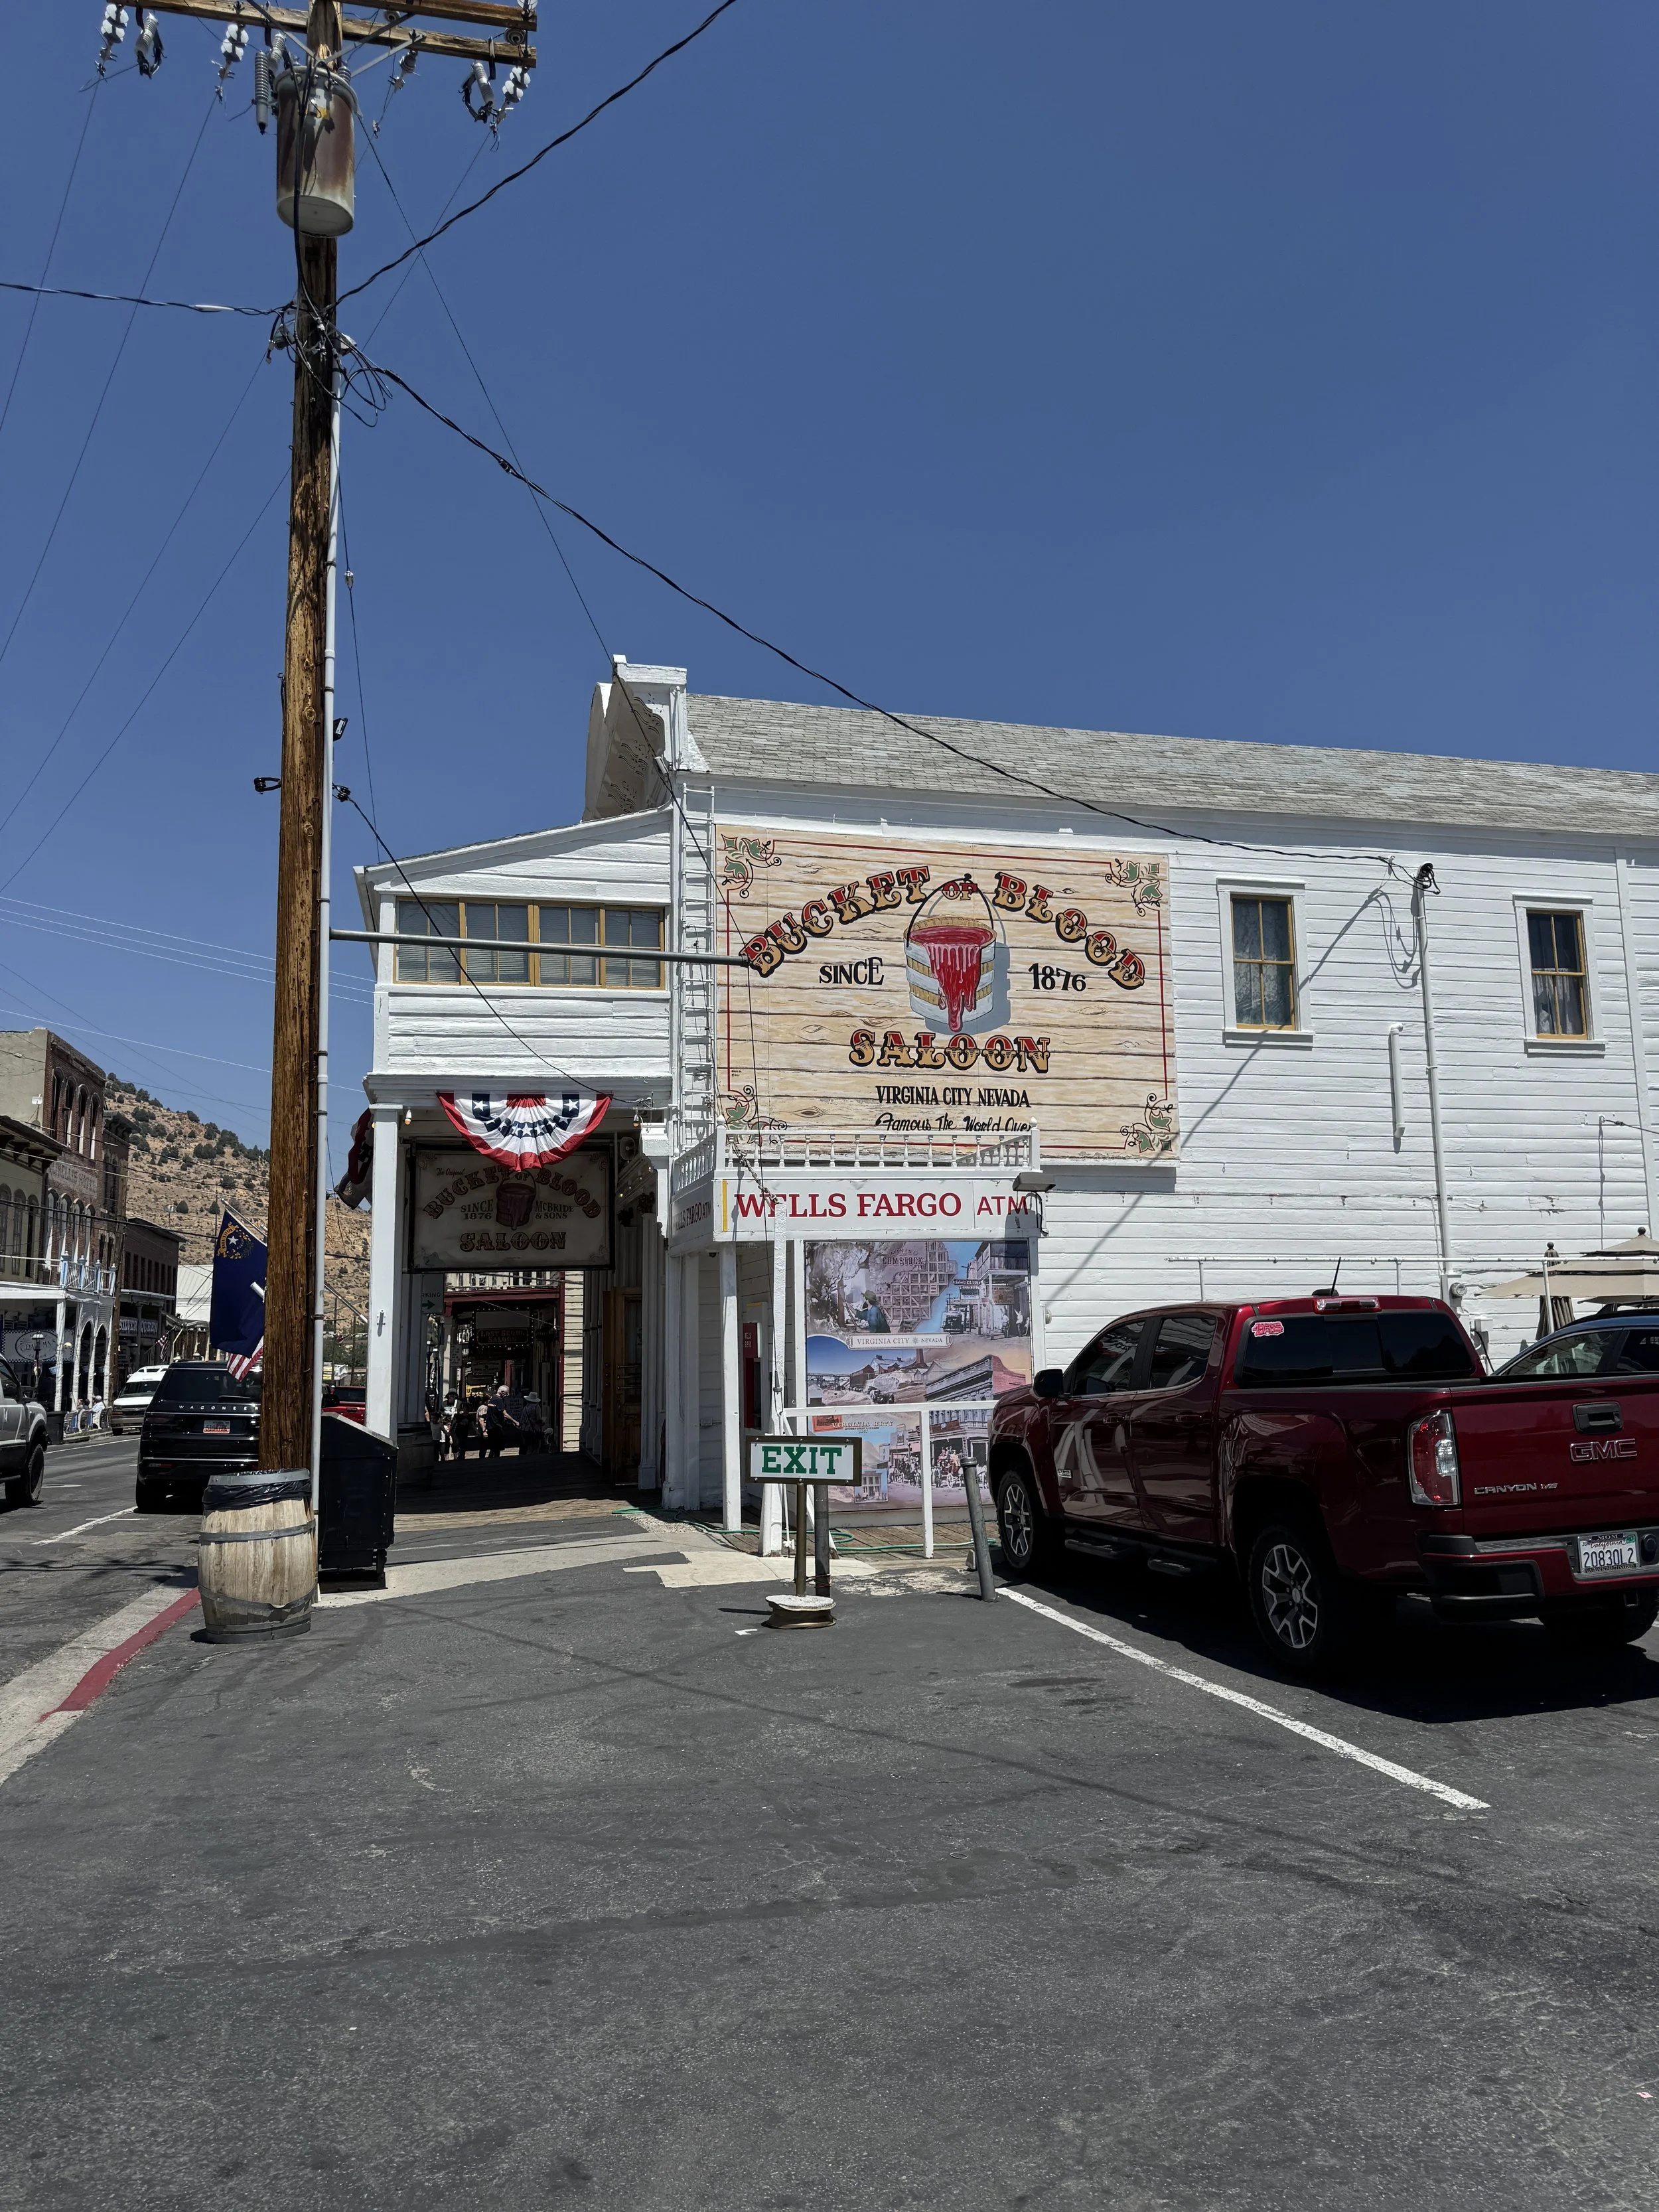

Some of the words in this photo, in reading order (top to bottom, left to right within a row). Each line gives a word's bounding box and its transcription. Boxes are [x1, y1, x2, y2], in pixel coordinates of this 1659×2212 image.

[739, 865, 931, 978] BUCKET
[942, 881, 979, 901] OF
[991, 871, 1145, 990] BLOOD
[819, 957, 885, 988] SINCE
[1027, 962, 1087, 992] 1876
[849, 1029, 1050, 1073] SALOON
[875, 1085, 940, 1105] VIRGINIA
[942, 1087, 973, 1106] CITY
[977, 1088, 1032, 1108] NEVADA
[875, 1112, 932, 1132] Famous
[935, 1112, 958, 1131] The
[962, 1115, 1001, 1132] World
[423, 1165, 510, 1219] BUCKET
[515, 1172, 530, 1181] OF
[535, 1167, 601, 1218] BLOOD
[461, 1199, 494, 1213] SINCE
[686, 1202, 702, 1226] FARGO
[702, 1200, 711, 1220] ATM
[856, 1192, 962, 1217] FARGO
[976, 1195, 1029, 1215] ATM
[460, 1232, 567, 1252] SALOON
[883, 1256, 925, 1266] COMSTOCK
[119, 1319, 137, 1331] SILVER
[140, 1320, 157, 1333] QUEEN
[761, 1445, 842, 1475] EXIT
[1570, 1438, 1638, 1461] GMC
[1474, 1483, 1538, 1495] CANYON
[1583, 1547, 1635, 1568] 20830L2
